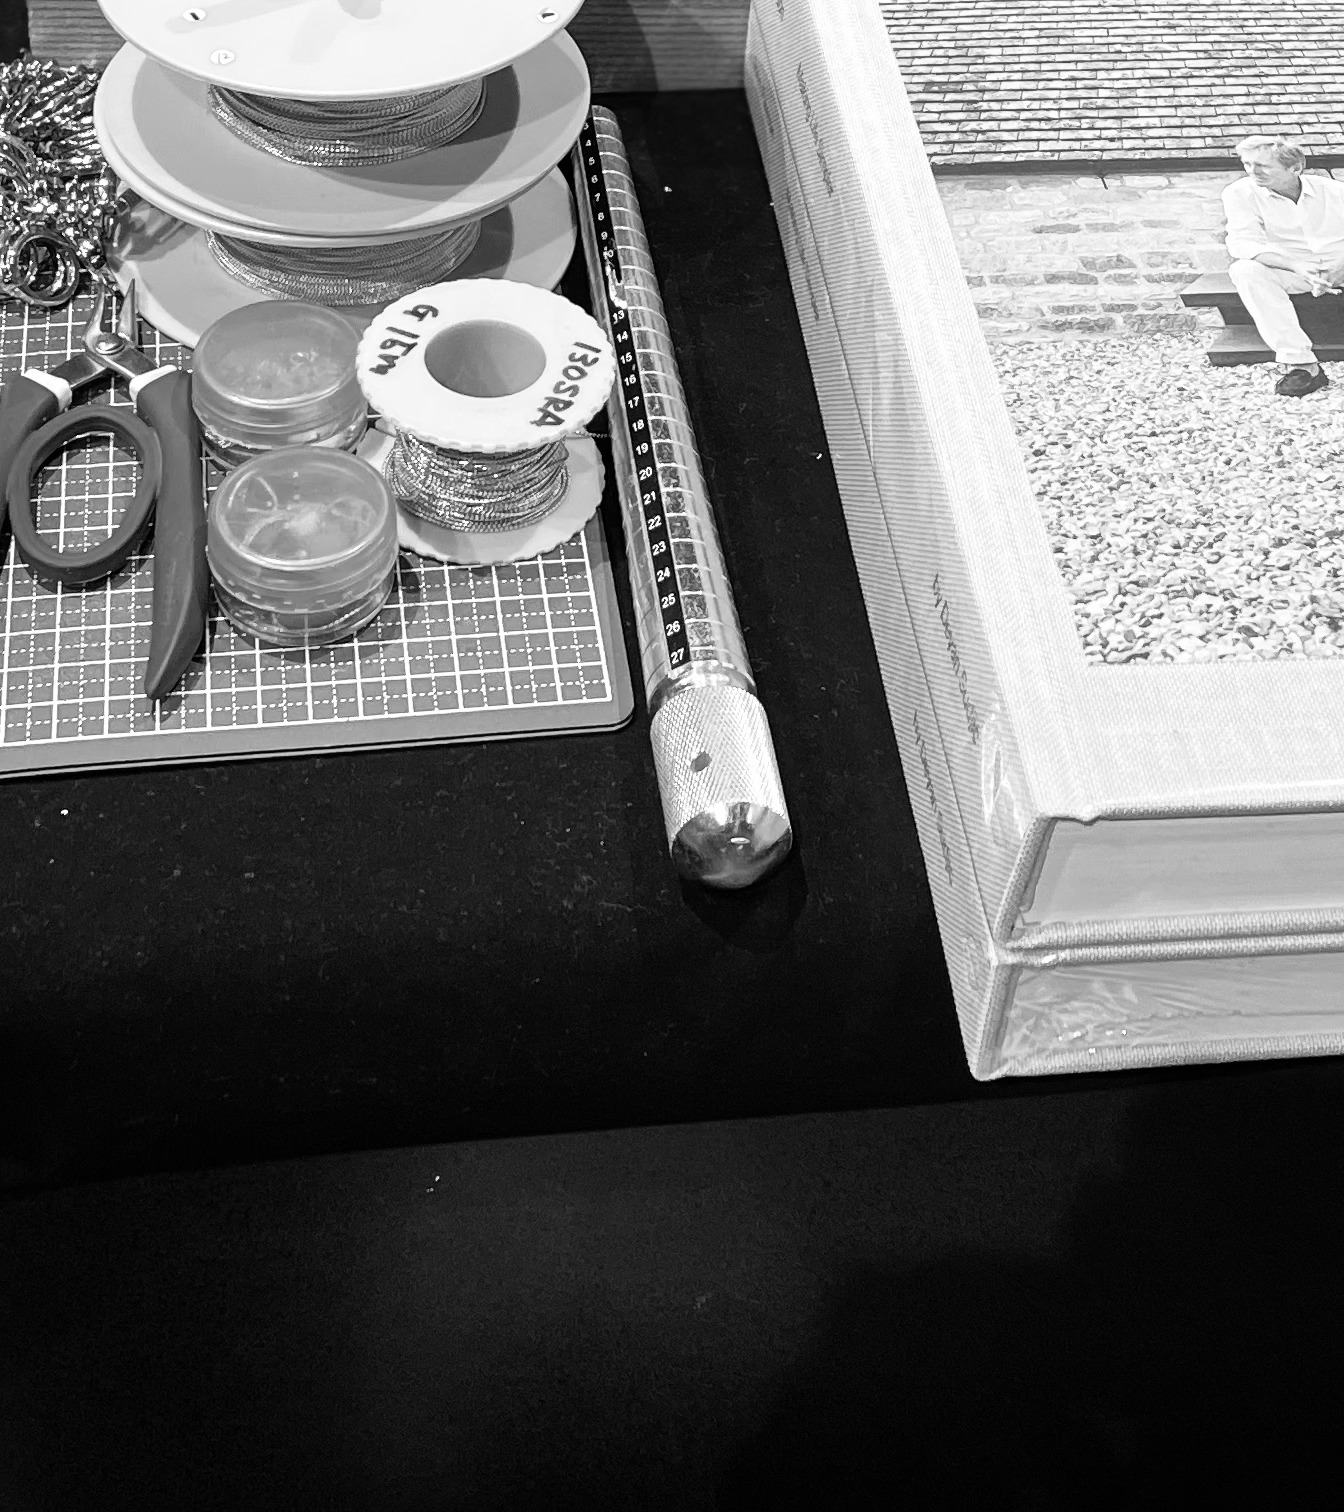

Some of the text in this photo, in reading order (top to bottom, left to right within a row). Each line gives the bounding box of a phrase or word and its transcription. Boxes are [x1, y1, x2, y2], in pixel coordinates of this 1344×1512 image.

[620, 351, 633, 365] 15
[623, 373, 637, 387] 16
[627, 395, 640, 409] 17
[632, 419, 645, 432] 18
[635, 442, 649, 456] 19
[638, 466, 653, 481] 20
[642, 490, 657, 506] 21
[647, 514, 663, 531] 22
[651, 540, 667, 557] 23
[656, 566, 671, 583] 24
[660, 592, 676, 609] 25
[664, 620, 681, 637] 26
[669, 647, 685, 665] 27
